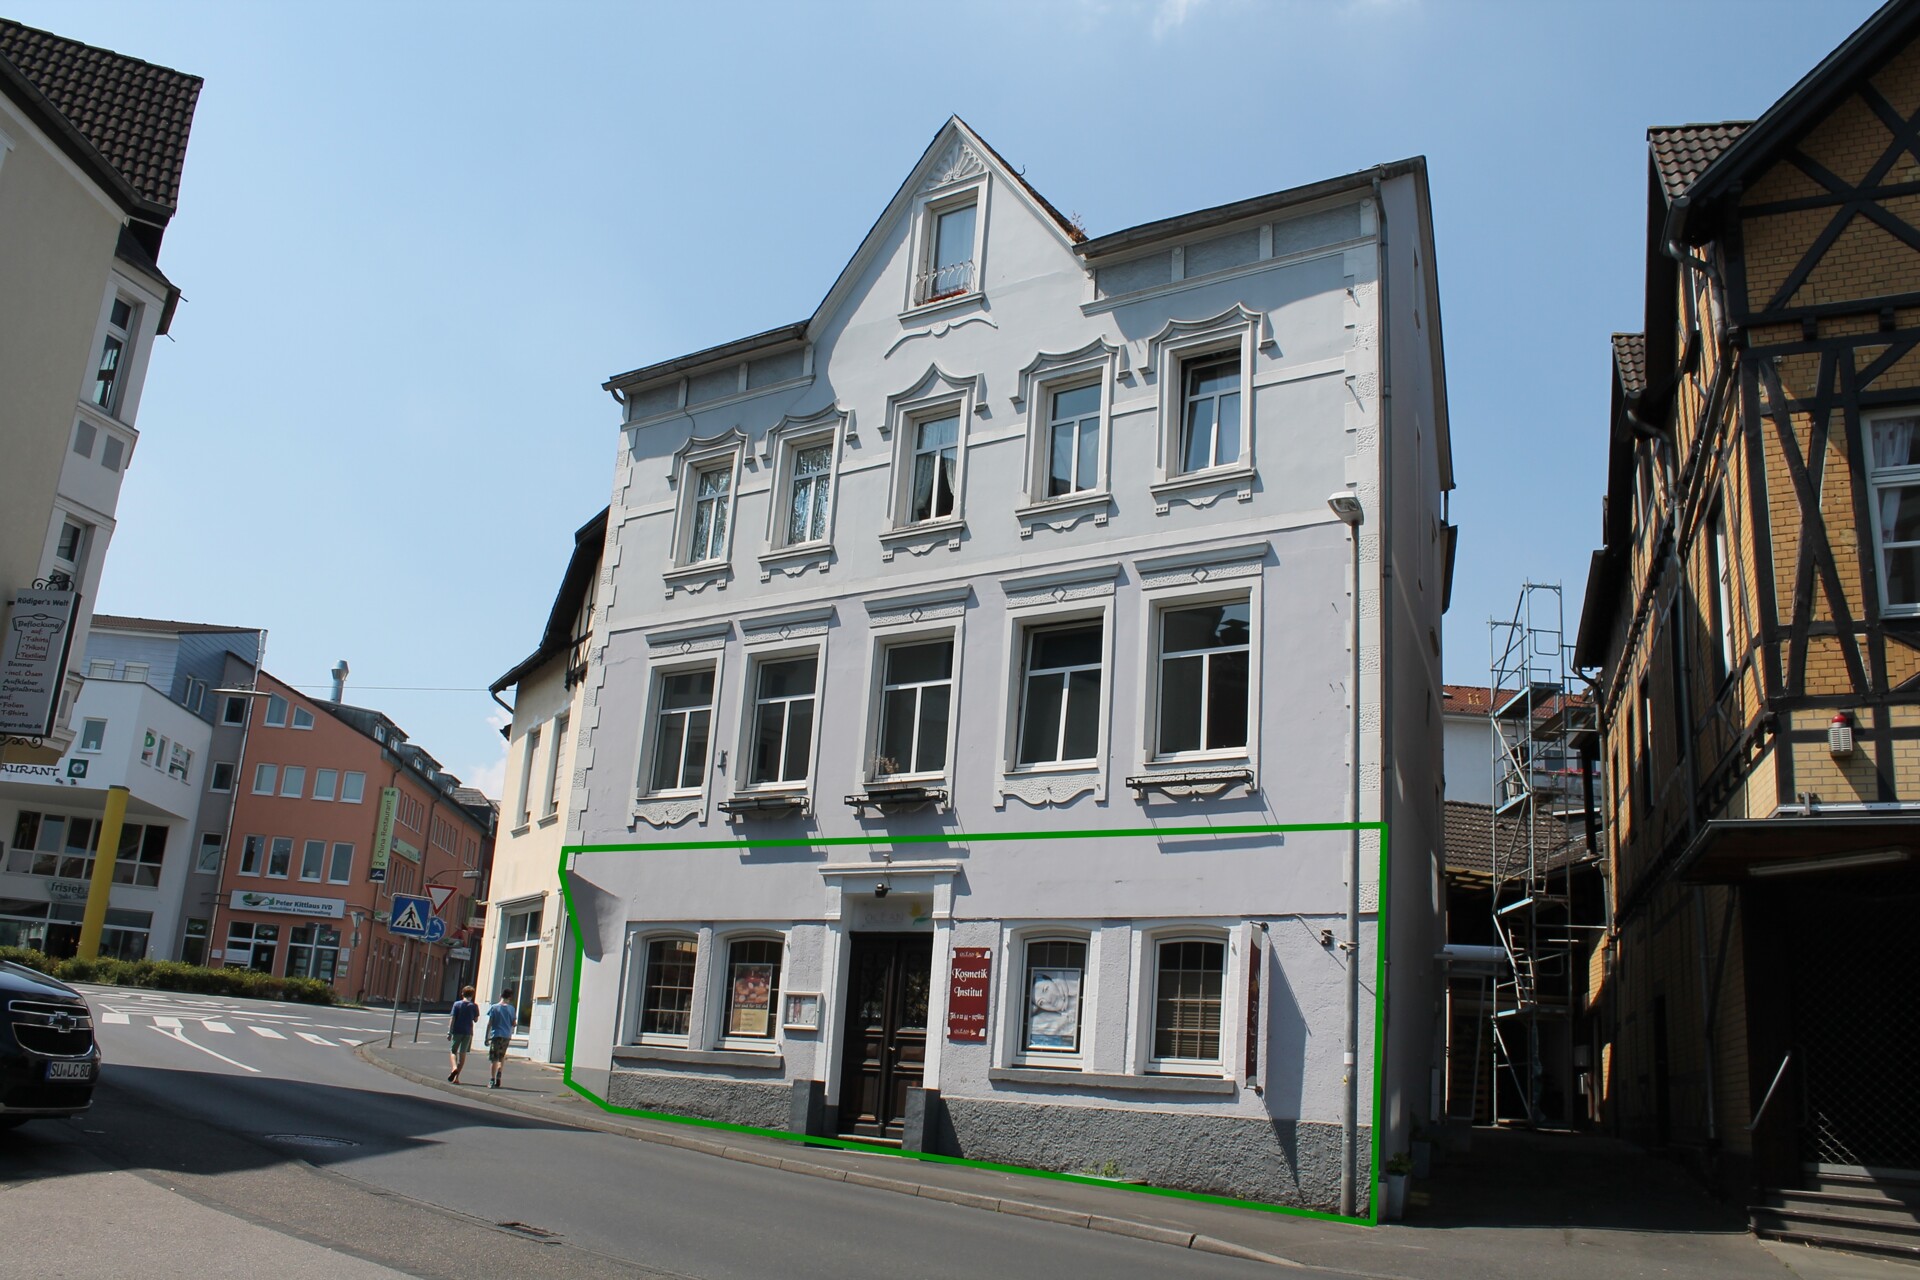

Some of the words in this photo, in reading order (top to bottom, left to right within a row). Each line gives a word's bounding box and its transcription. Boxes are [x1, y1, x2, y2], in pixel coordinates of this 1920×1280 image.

[17, 597, 50, 606] Rüdiger's
[18, 621, 60, 629] Beflockung
[2, 685, 45, 693] Digitaldruck
[378, 800, 391, 858] China-Restaurant
[295, 901, 320, 909] Kittlaus
[952, 968, 987, 982] Kosmetik
[954, 986, 982, 997] Institut
[51, 1063, 63, 1076] SU
[67, 1064, 79, 1077] LC
[80, 1064, 90, 1077] 80
